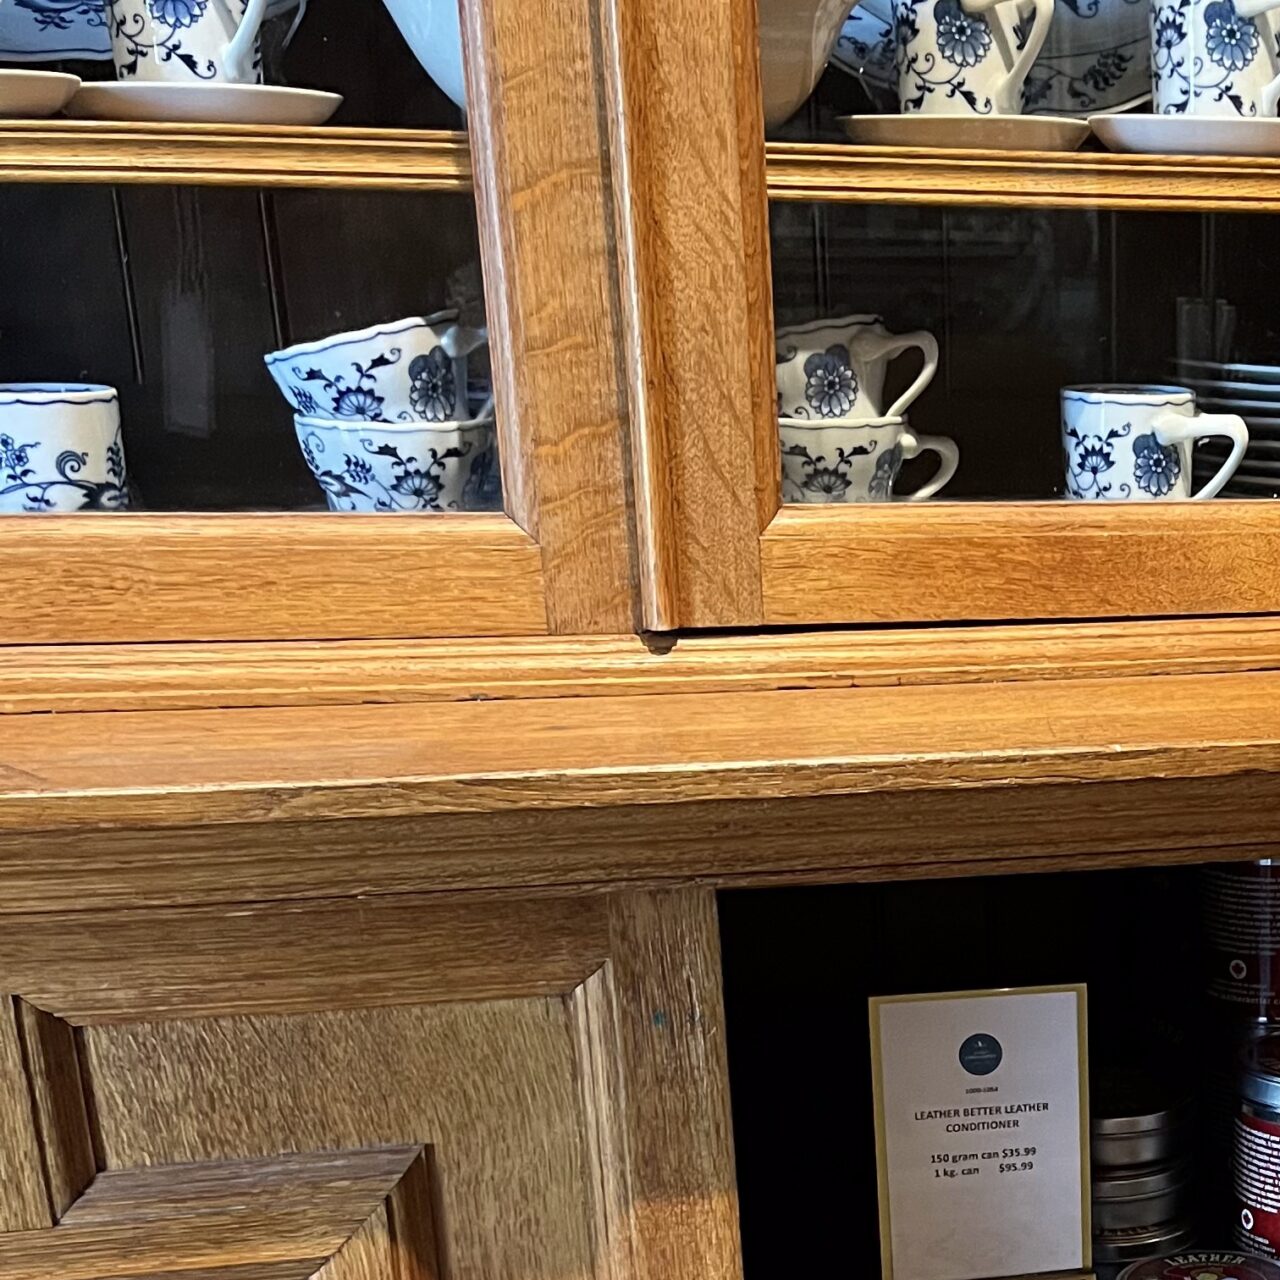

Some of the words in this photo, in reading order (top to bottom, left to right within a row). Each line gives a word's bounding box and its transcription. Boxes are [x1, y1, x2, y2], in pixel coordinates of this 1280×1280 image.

[914, 1109, 960, 1121] LEATHER
[963, 1106, 1002, 1117] BETTER
[1004, 1102, 1049, 1114] LEATHER
[946, 1119, 1020, 1132] CONDITIONER
[930, 1153, 950, 1164] 150
[951, 1154, 978, 1164] gram
[981, 1151, 999, 1160] can
[1002, 1146, 1037, 1159] $35.99
[934, 1169, 941, 1178] 1
[961, 1166, 980, 1175] can
[999, 1161, 1034, 1174] $95.99
[1163, 1253, 1247, 1266] LEATHER
